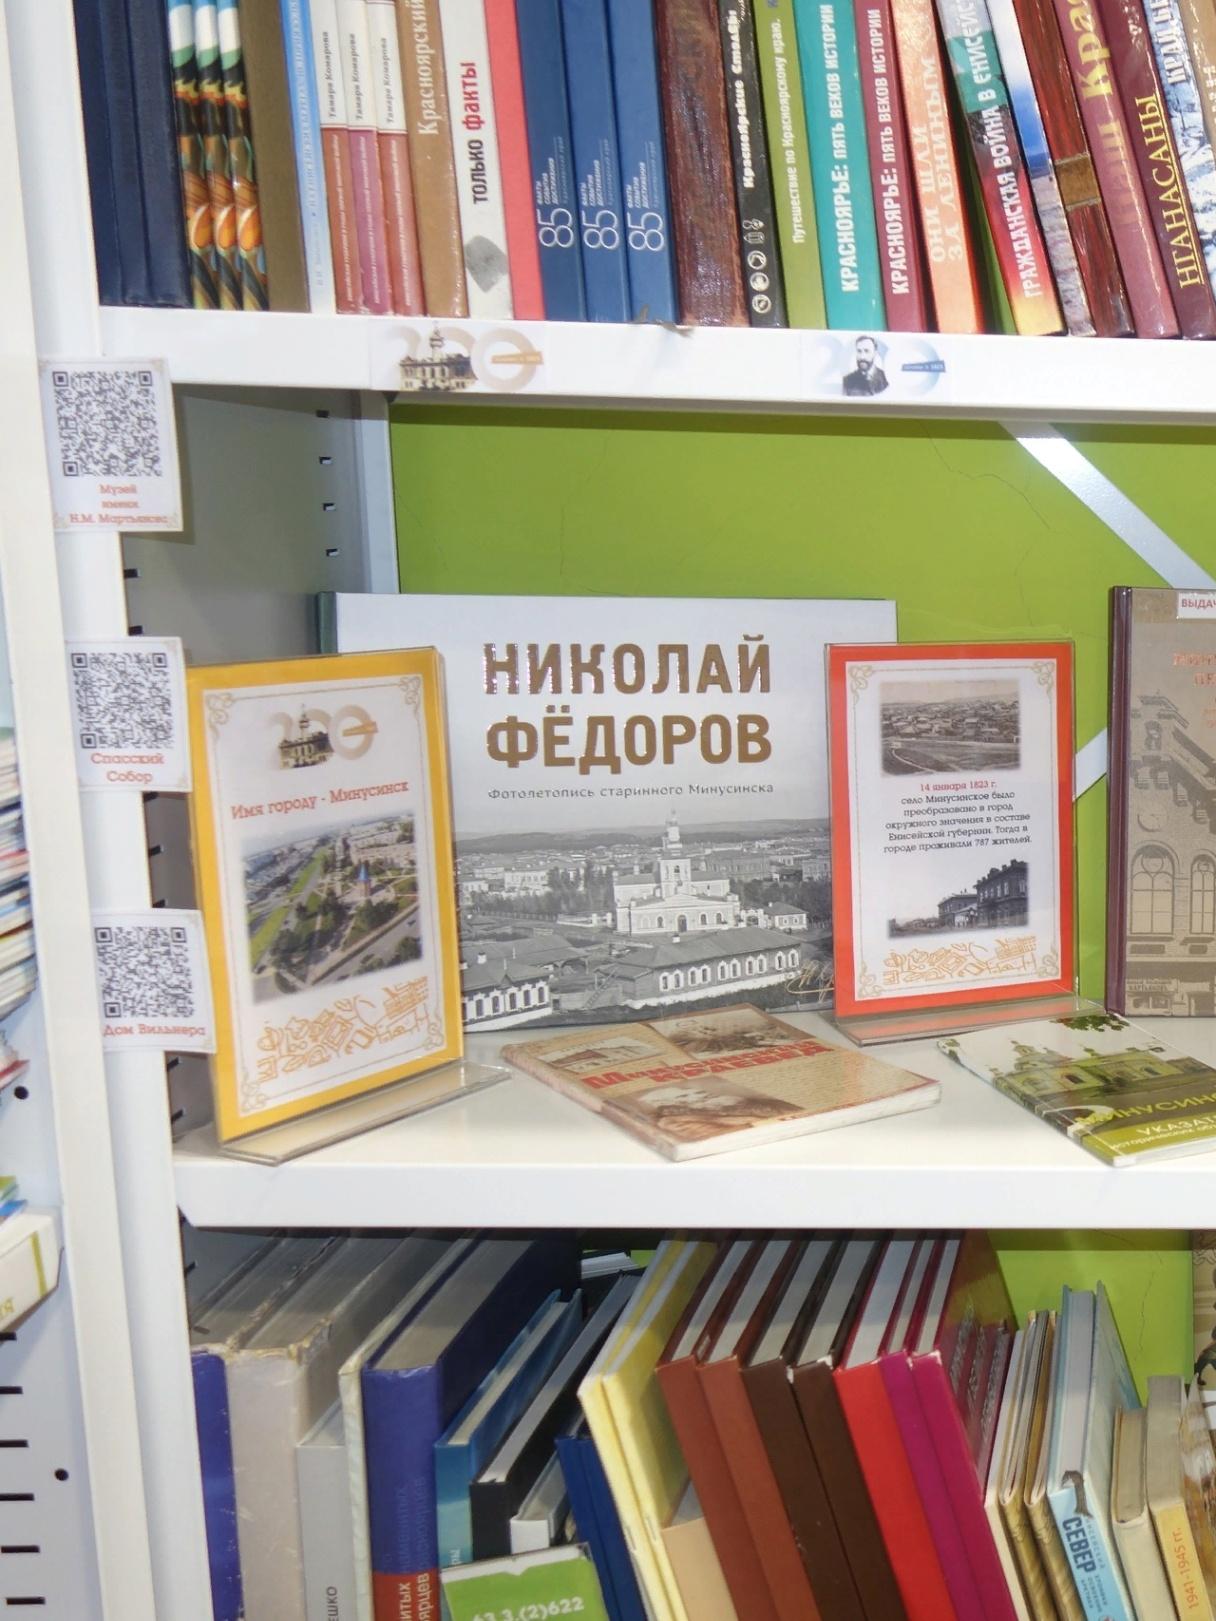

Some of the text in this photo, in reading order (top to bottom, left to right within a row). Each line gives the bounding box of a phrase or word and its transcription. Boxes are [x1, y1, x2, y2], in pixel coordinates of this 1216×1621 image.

[775, 57, 796, 148] Красноярскому
[977, 89, 997, 102] В
[460, 62, 488, 205] только факты
[785, 150, 796, 164] по
[820, 5, 860, 292] КРАСНОЯРЬЕ: ПЯТЬ ВЕКОВ ИСТОРИИ
[867, 9, 910, 295] КРАСНОЯРЬЕ: ПЯТЬ ВЕКОВ ИСТОРИИ
[981, 105, 1013, 169] ВОЙНА
[785, 167, 806, 244] Путешествие
[1135, 94, 1203, 288] НГАНАСАНЫ
[536, 208, 574, 248] 85
[581, 210, 619, 249] 85
[627, 212, 664, 251] 85
[997, 171, 1042, 298] ГРАЖДАНСКАЯ
[483, 634, 770, 695] НИКОЛАЙ
[486, 705, 772, 775] ФЁДОРОВ
[107, 771, 153, 784] Собор
[231, 781, 409, 820] Имя городу Минусинск
[487, 783, 774, 800] Фотолетопись старинного Минусинска
[103, 1023, 135, 1039] Дом
[1062, 1516, 1097, 1573] СЕВЕР
[1173, 1546, 1200, 1609] 1941-1945
